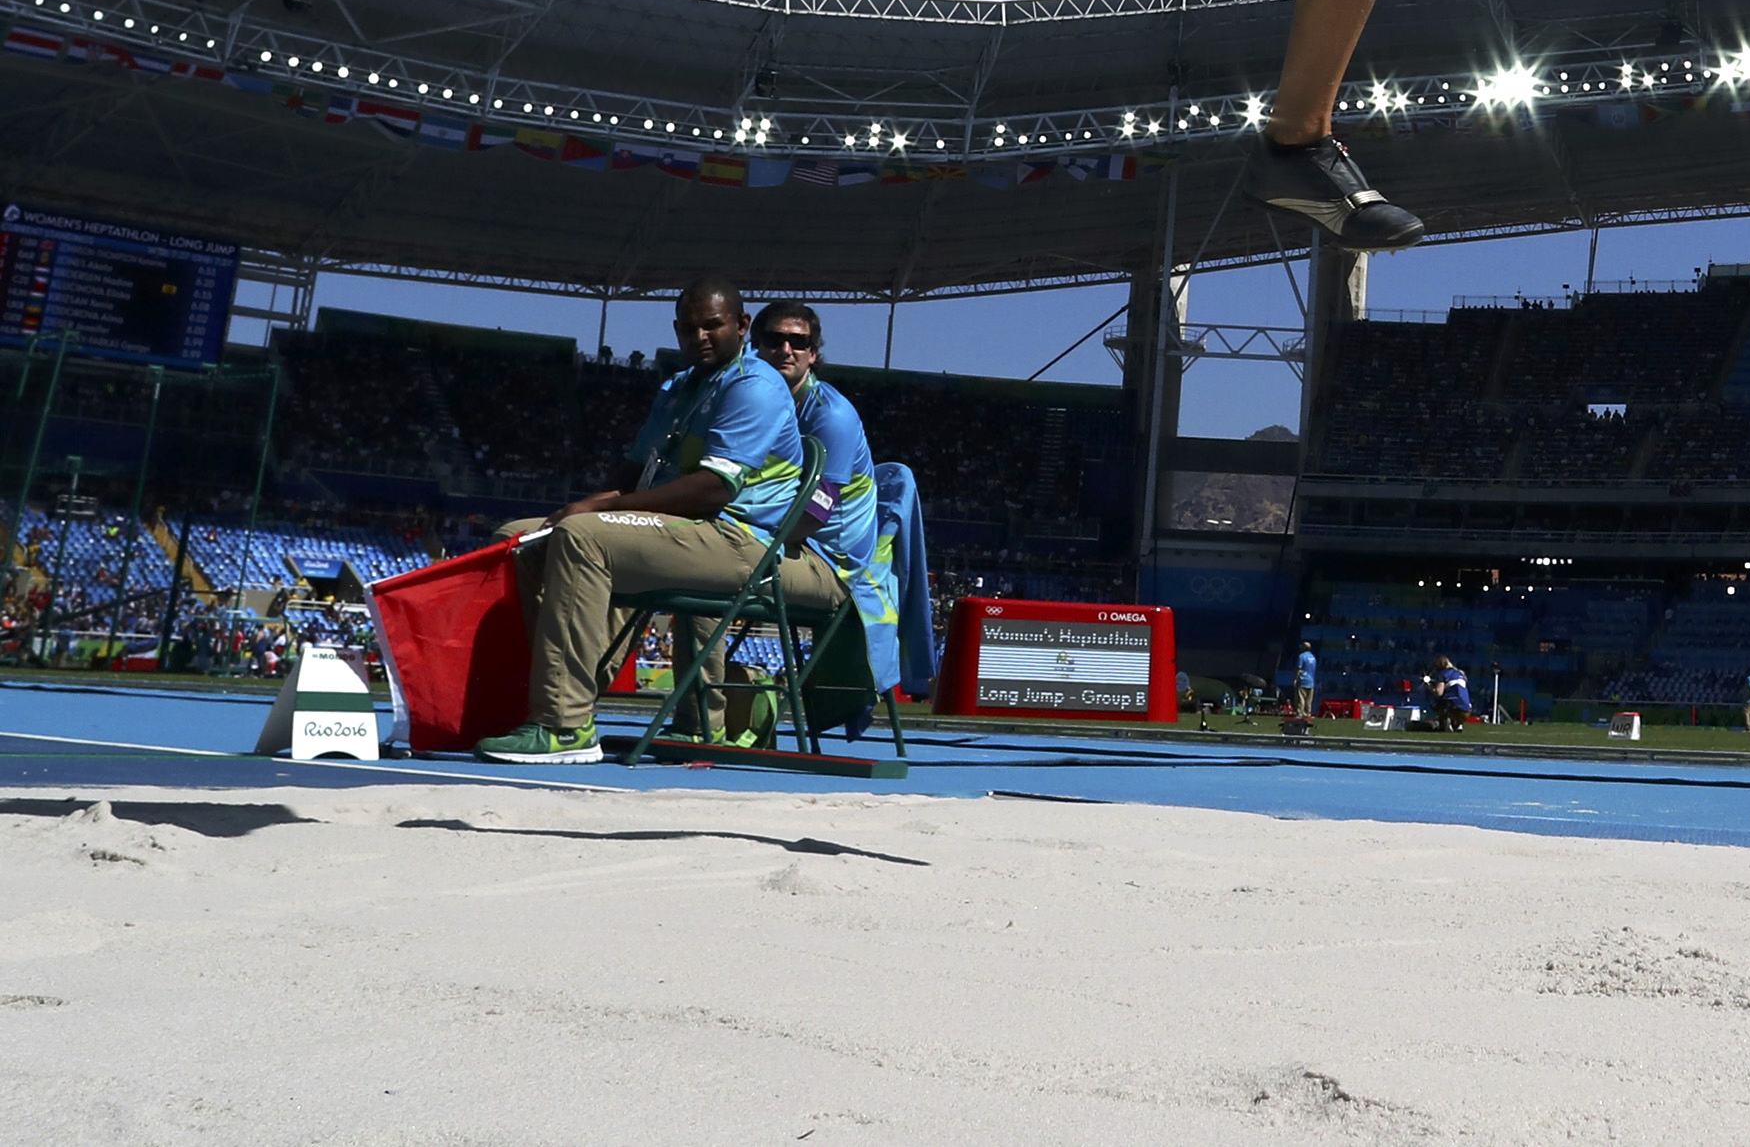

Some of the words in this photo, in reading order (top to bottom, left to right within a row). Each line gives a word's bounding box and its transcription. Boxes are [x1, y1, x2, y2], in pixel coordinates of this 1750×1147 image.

[24, 211, 82, 231] WOMEN'S
[84, 222, 160, 244] HEPTATHLON
[169, 236, 202, 252] LONG
[206, 241, 236, 256] JUMP
[598, 513, 664, 527] Rio2016
[1110, 612, 1147, 622] OMEGA
[983, 624, 1055, 643] Women's
[1059, 629, 1149, 647] Heptathlon
[979, 685, 1019, 706] Long
[1023, 687, 1064, 707] Jump
[1081, 689, 1132, 709] Group
[1136, 691, 1146, 706] B
[304, 721, 367, 737] Rio2016
